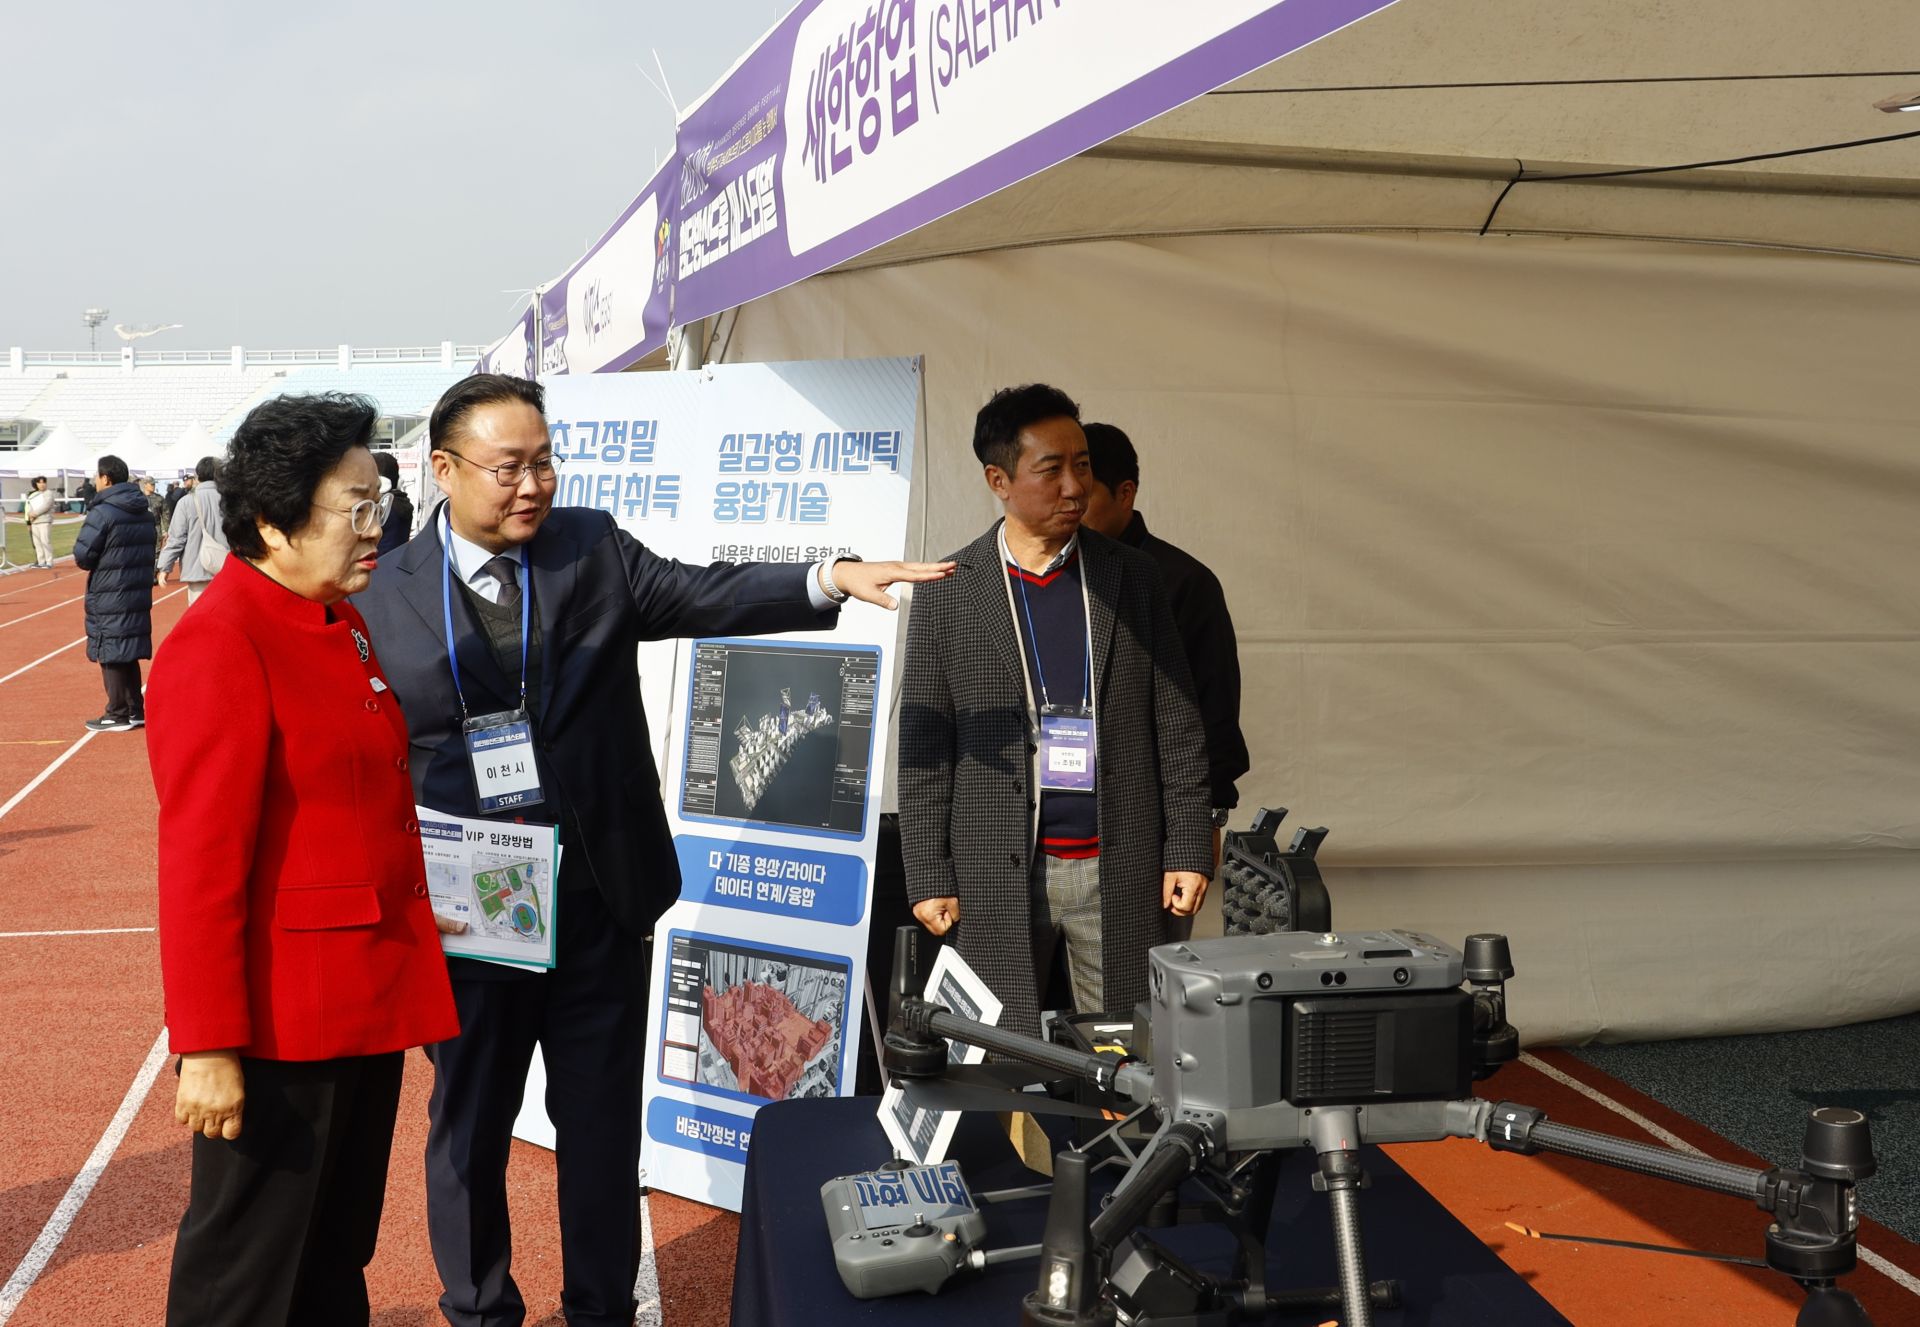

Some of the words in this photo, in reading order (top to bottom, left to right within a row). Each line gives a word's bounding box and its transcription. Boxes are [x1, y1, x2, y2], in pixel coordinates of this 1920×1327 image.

[802, 0, 919, 184] 새한항업
[549, 419, 658, 463] 초고정밀
[718, 431, 802, 473] 실감형
[810, 430, 902, 473] 시멘틱
[713, 481, 830, 523] 융합기술
[757, 545, 800, 563] 데이터
[498, 794, 524, 806] STAFF
[466, 830, 485, 841] VIP
[490, 833, 533, 849] 입장방법
[709, 851, 722, 870] 다
[726, 852, 751, 874] 기종
[754, 857, 826, 884] 영상/라이다
[715, 876, 752, 899] 데이터
[756, 882, 816, 908] 연계/융합
[676, 1115, 736, 1148] 비공간정보
